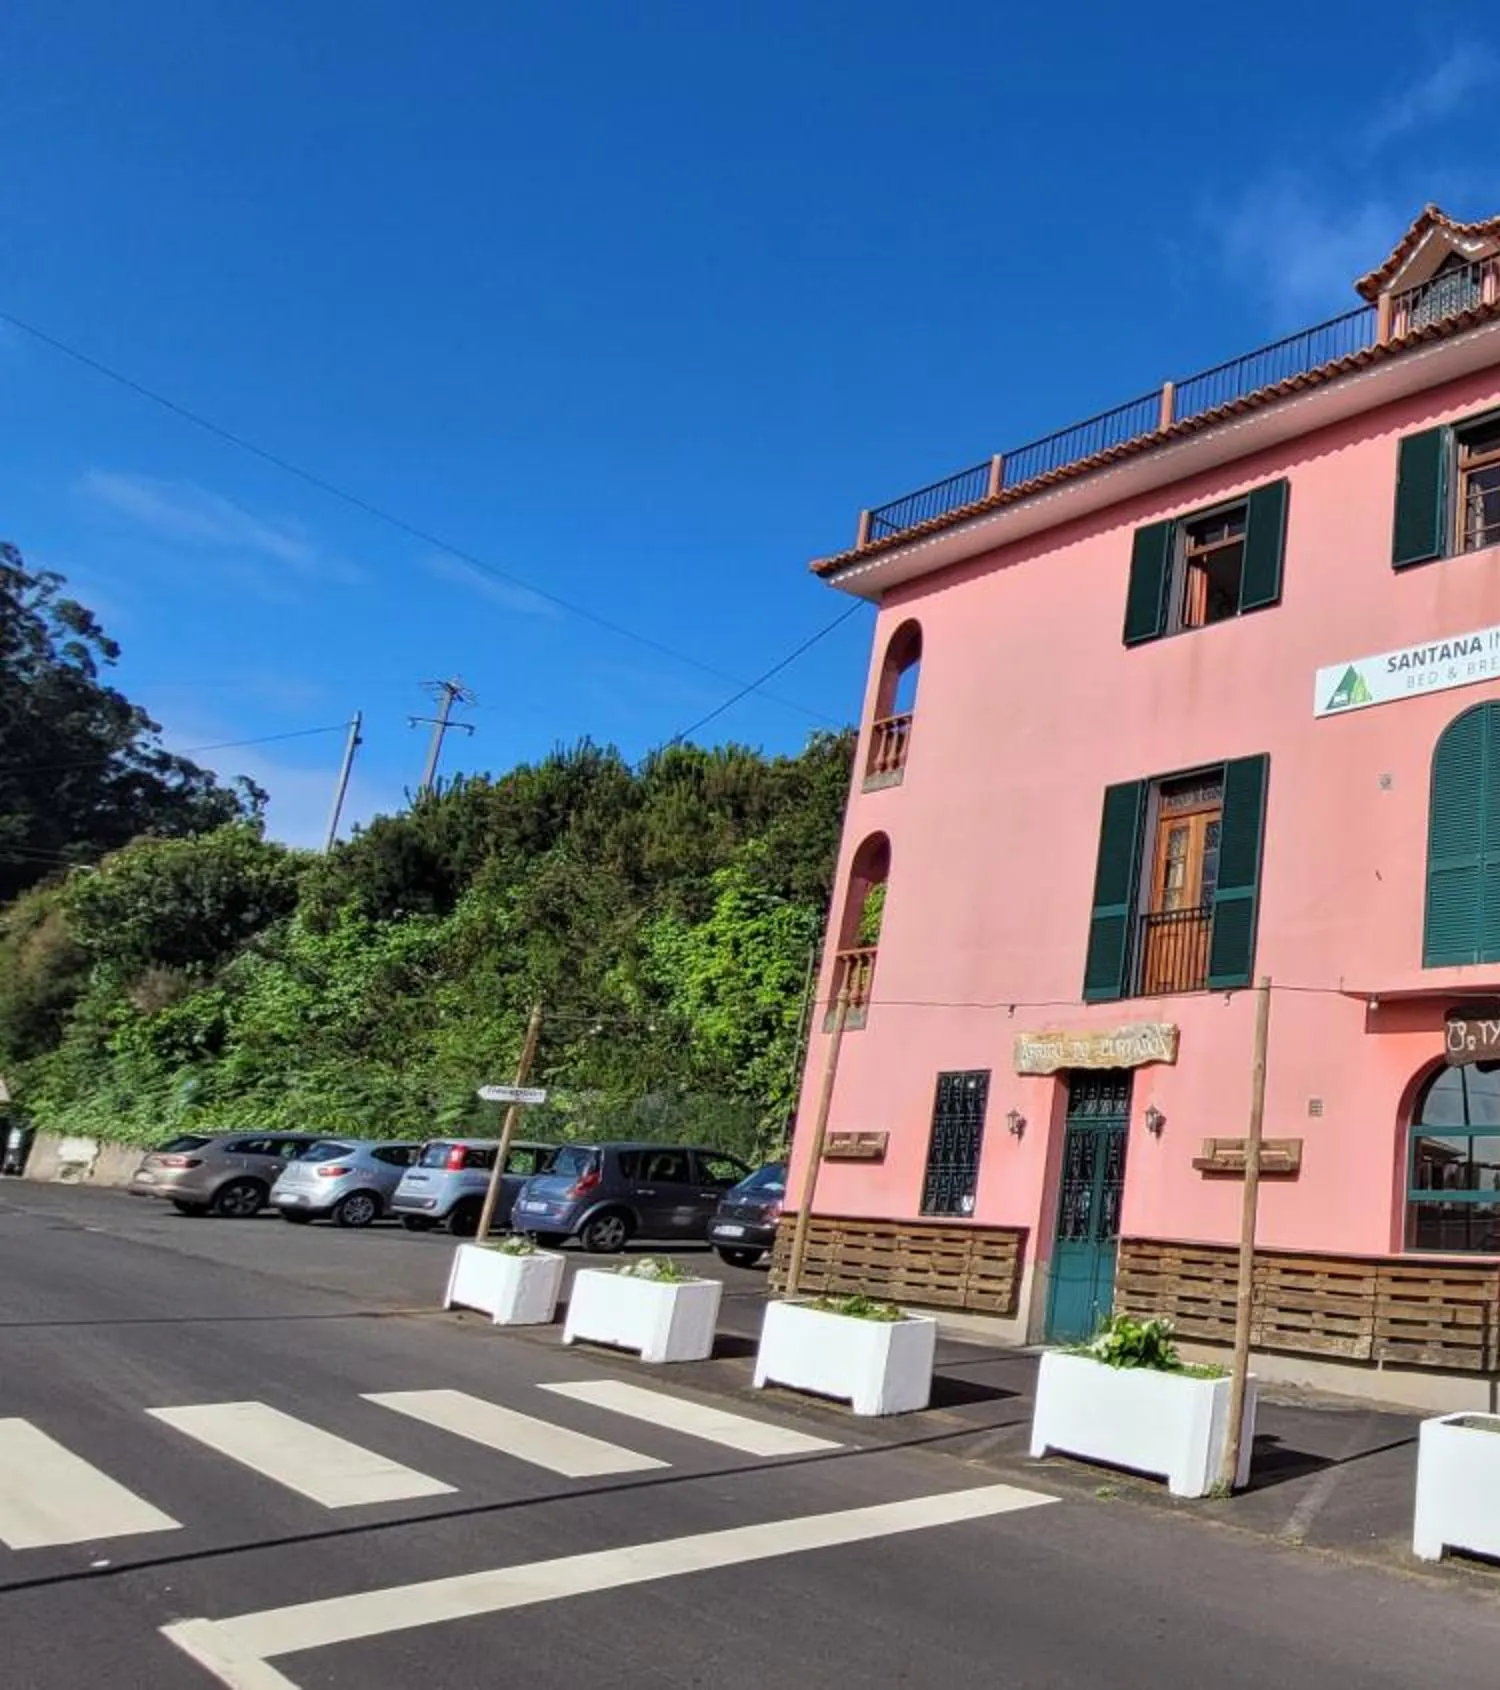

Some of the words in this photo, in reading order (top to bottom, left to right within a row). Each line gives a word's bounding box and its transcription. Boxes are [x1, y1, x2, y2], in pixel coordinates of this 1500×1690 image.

[1386, 636, 1483, 674] SANTANA
[1406, 671, 1444, 689] BED
[1447, 666, 1458, 681] &
